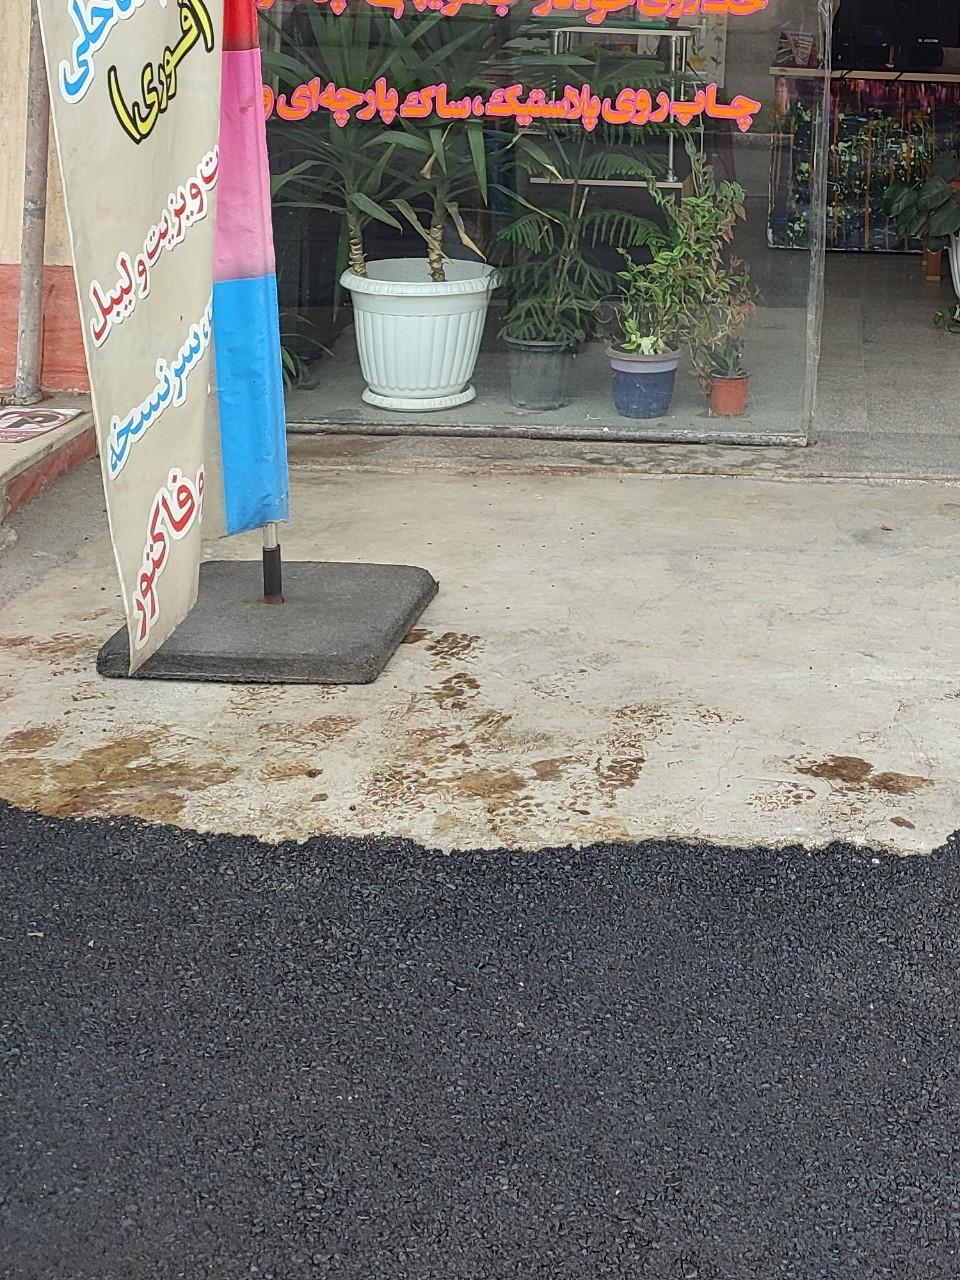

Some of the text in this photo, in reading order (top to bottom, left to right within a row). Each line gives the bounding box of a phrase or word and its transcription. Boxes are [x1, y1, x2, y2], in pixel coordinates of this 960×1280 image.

[400, 82, 471, 118] ساک
[601, 87, 669, 125] روی
[669, 82, 761, 132] چاپ
[91, 251, 136, 347] لیبل
[134, 466, 199, 648] فاکتور
